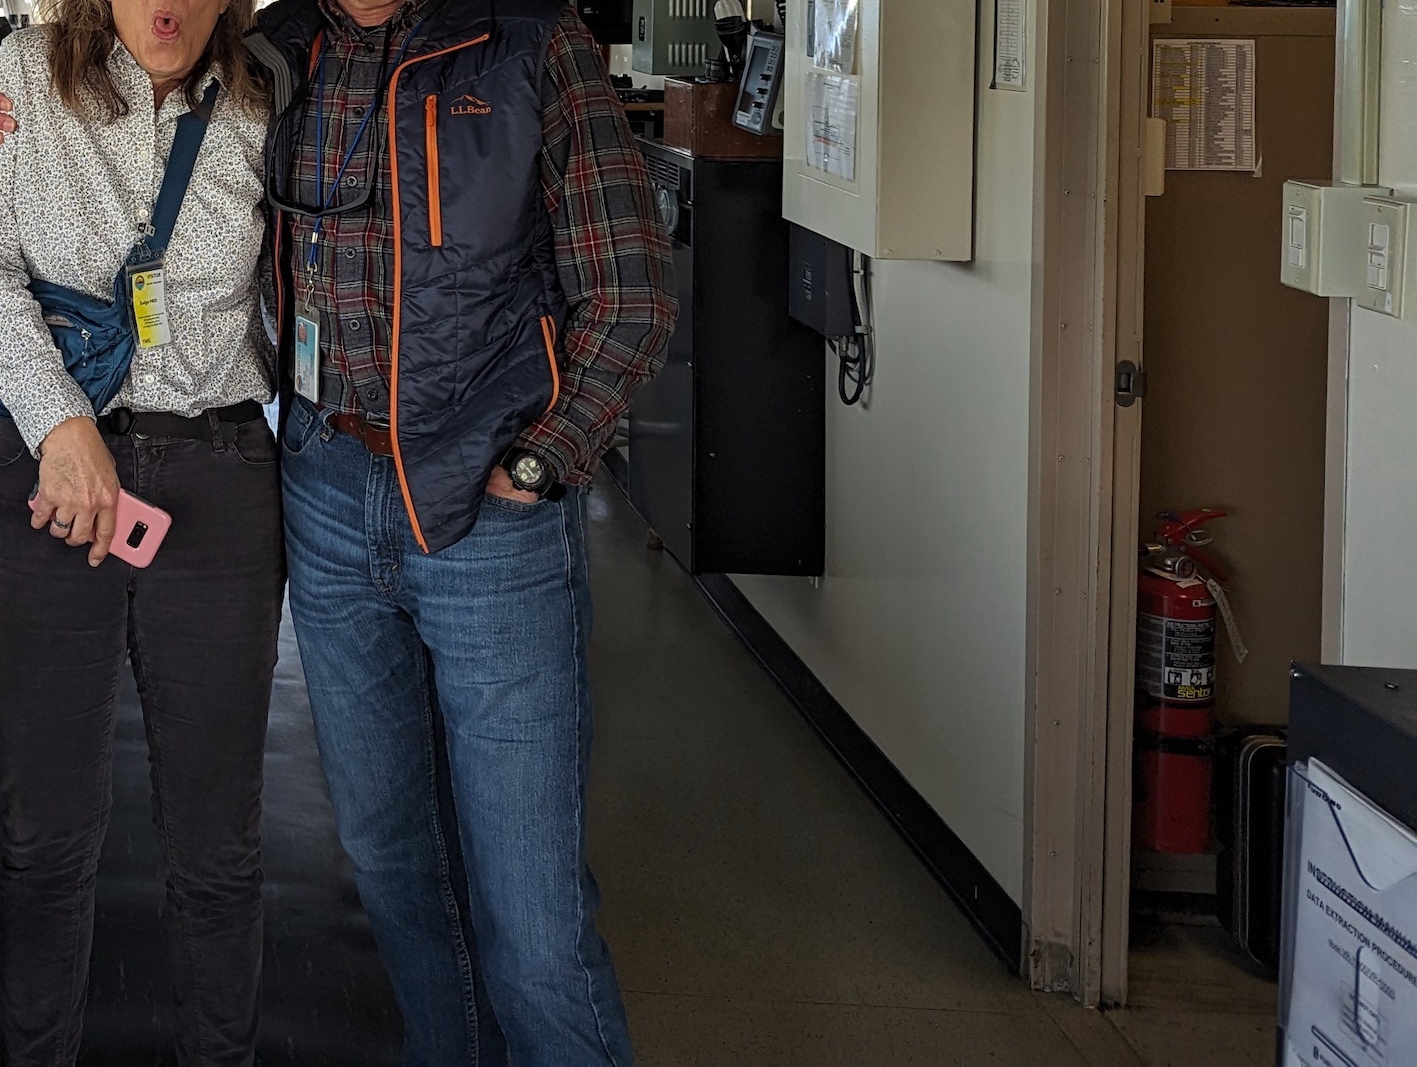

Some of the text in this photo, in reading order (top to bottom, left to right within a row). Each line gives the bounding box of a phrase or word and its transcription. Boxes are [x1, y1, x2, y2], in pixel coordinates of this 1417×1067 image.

[450, 105, 492, 115] L.L.Bean
[1306, 888, 1325, 911] DATA
[1325, 905, 1371, 949] EXTRACTION
